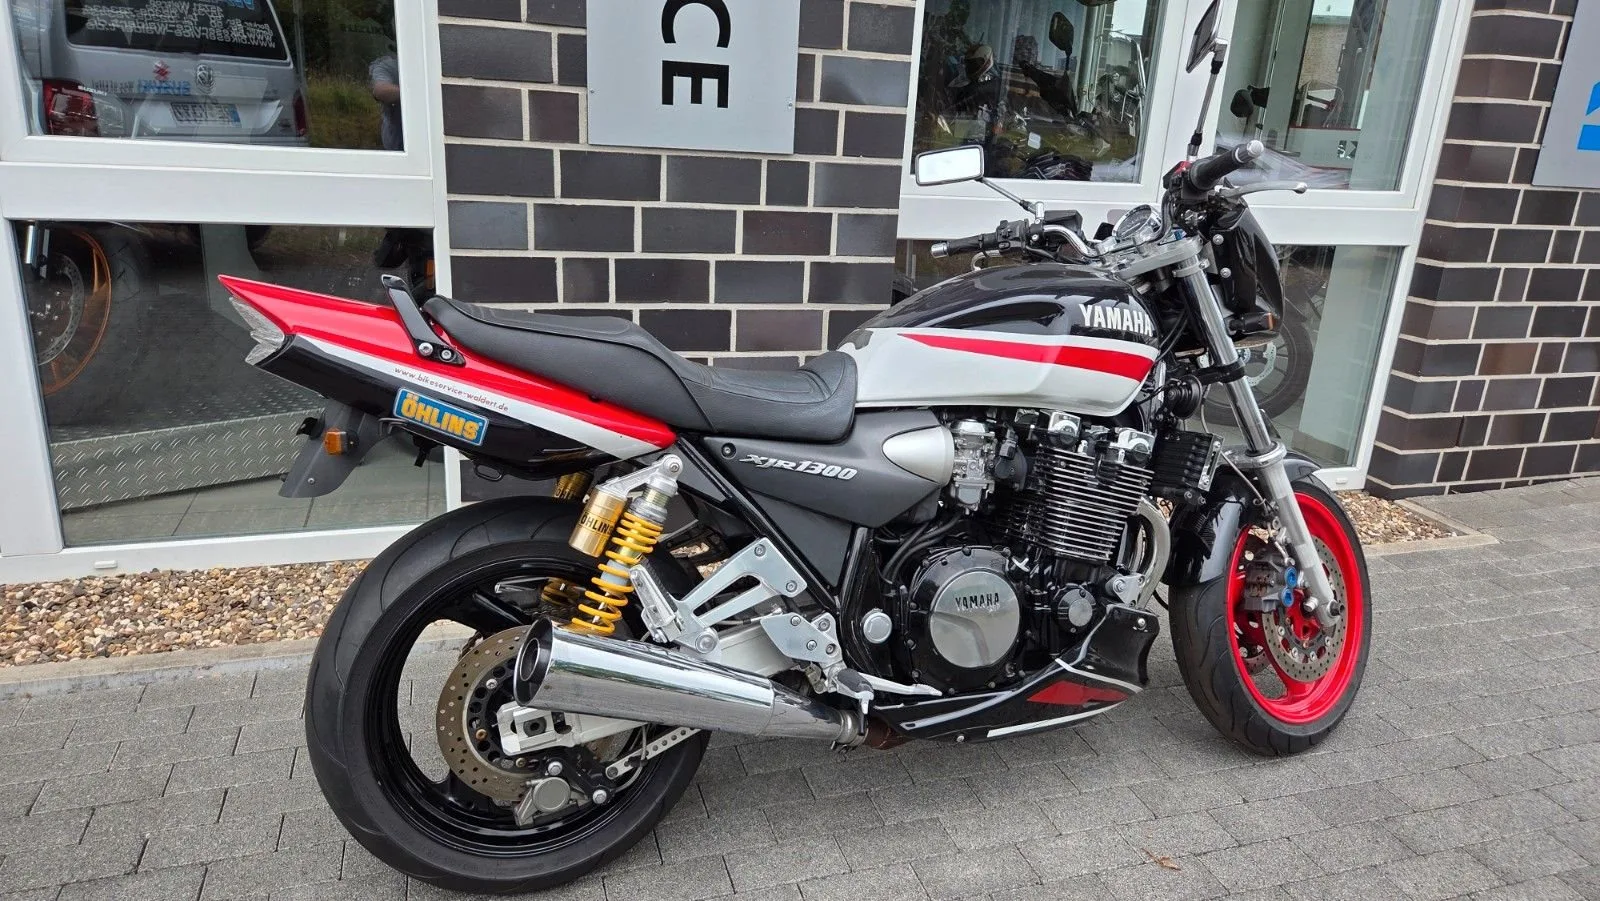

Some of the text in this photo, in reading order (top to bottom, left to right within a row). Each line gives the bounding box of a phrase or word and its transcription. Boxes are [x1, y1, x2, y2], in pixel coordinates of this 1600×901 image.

[1079, 304, 1153, 337] YAMAHA
[394, 368, 508, 411] www.bikeservice-waldert.de
[401, 392, 479, 440] ÖHLINS
[739, 454, 858, 480] XJR1300
[955, 592, 1000, 610] YAMAHA
